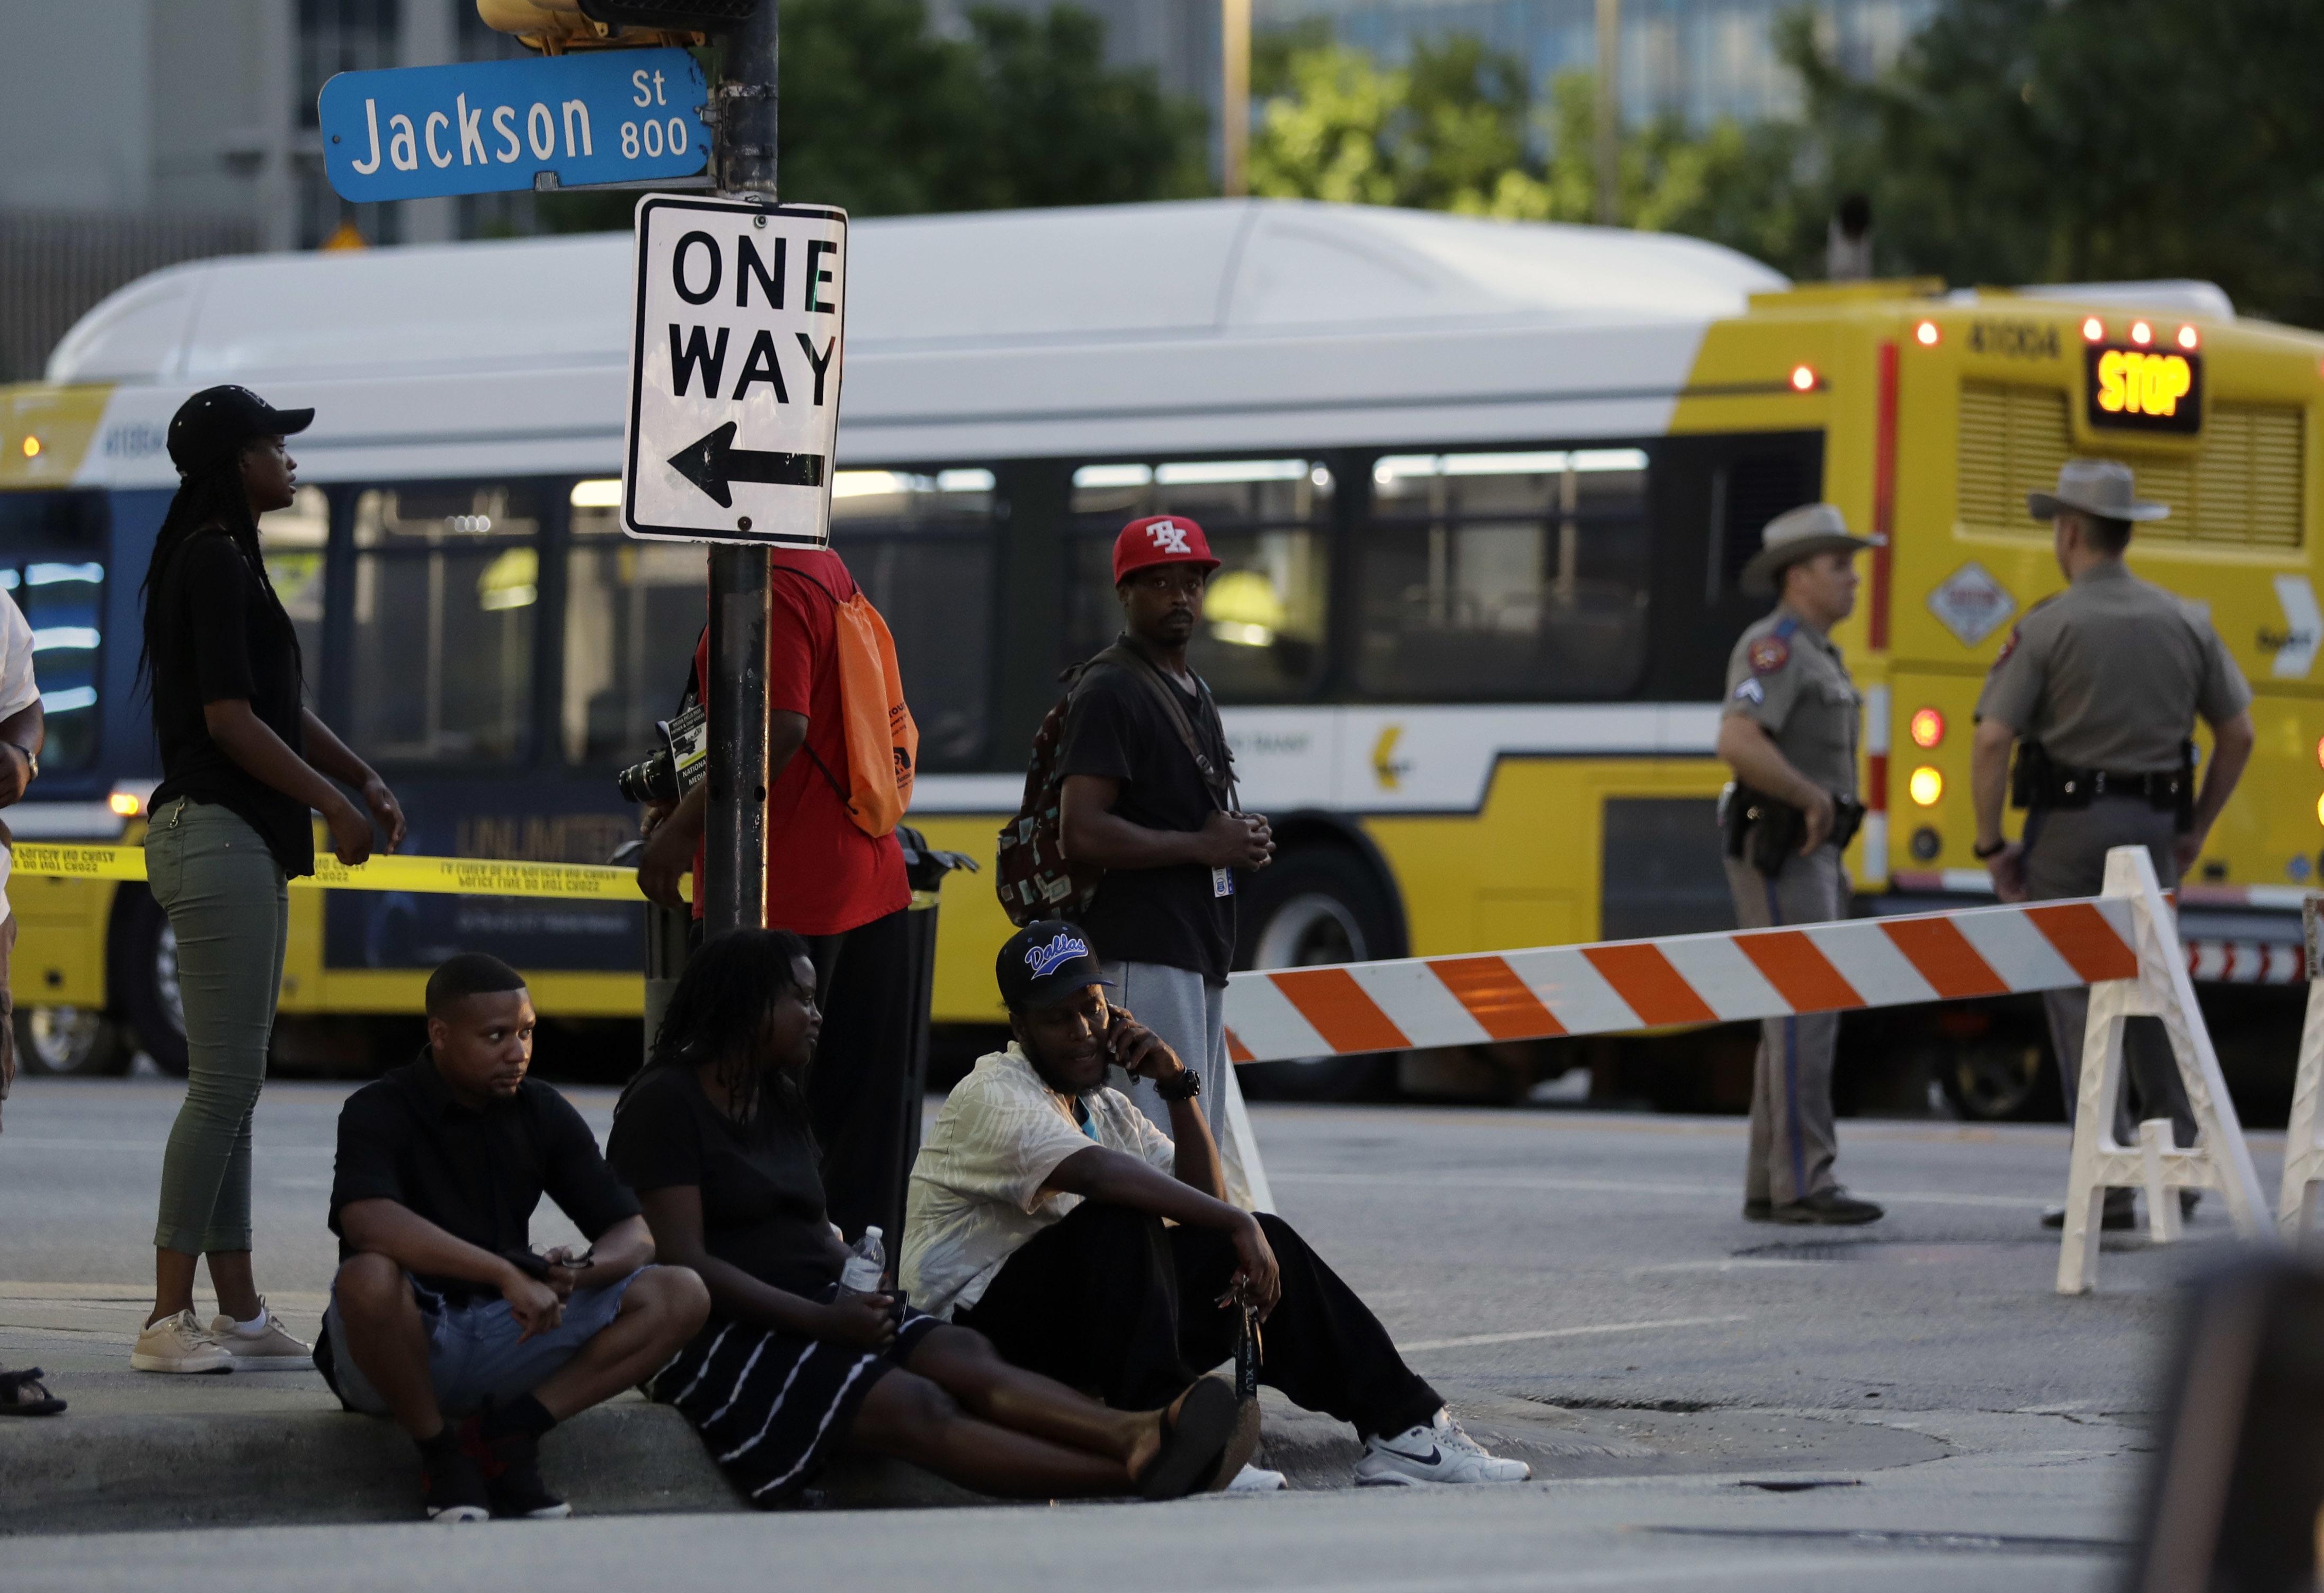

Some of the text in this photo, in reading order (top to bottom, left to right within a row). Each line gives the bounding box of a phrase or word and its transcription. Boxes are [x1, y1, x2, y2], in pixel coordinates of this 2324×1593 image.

[633, 69, 667, 108] St
[352, 92, 593, 175] Jackson
[621, 117, 688, 159] 800
[672, 230, 838, 315] ONE
[669, 323, 836, 406] WAY
[2098, 350, 2191, 416] STOP
[689, 771, 706, 786] MEDIA
[1025, 933, 1088, 971] Dallas
